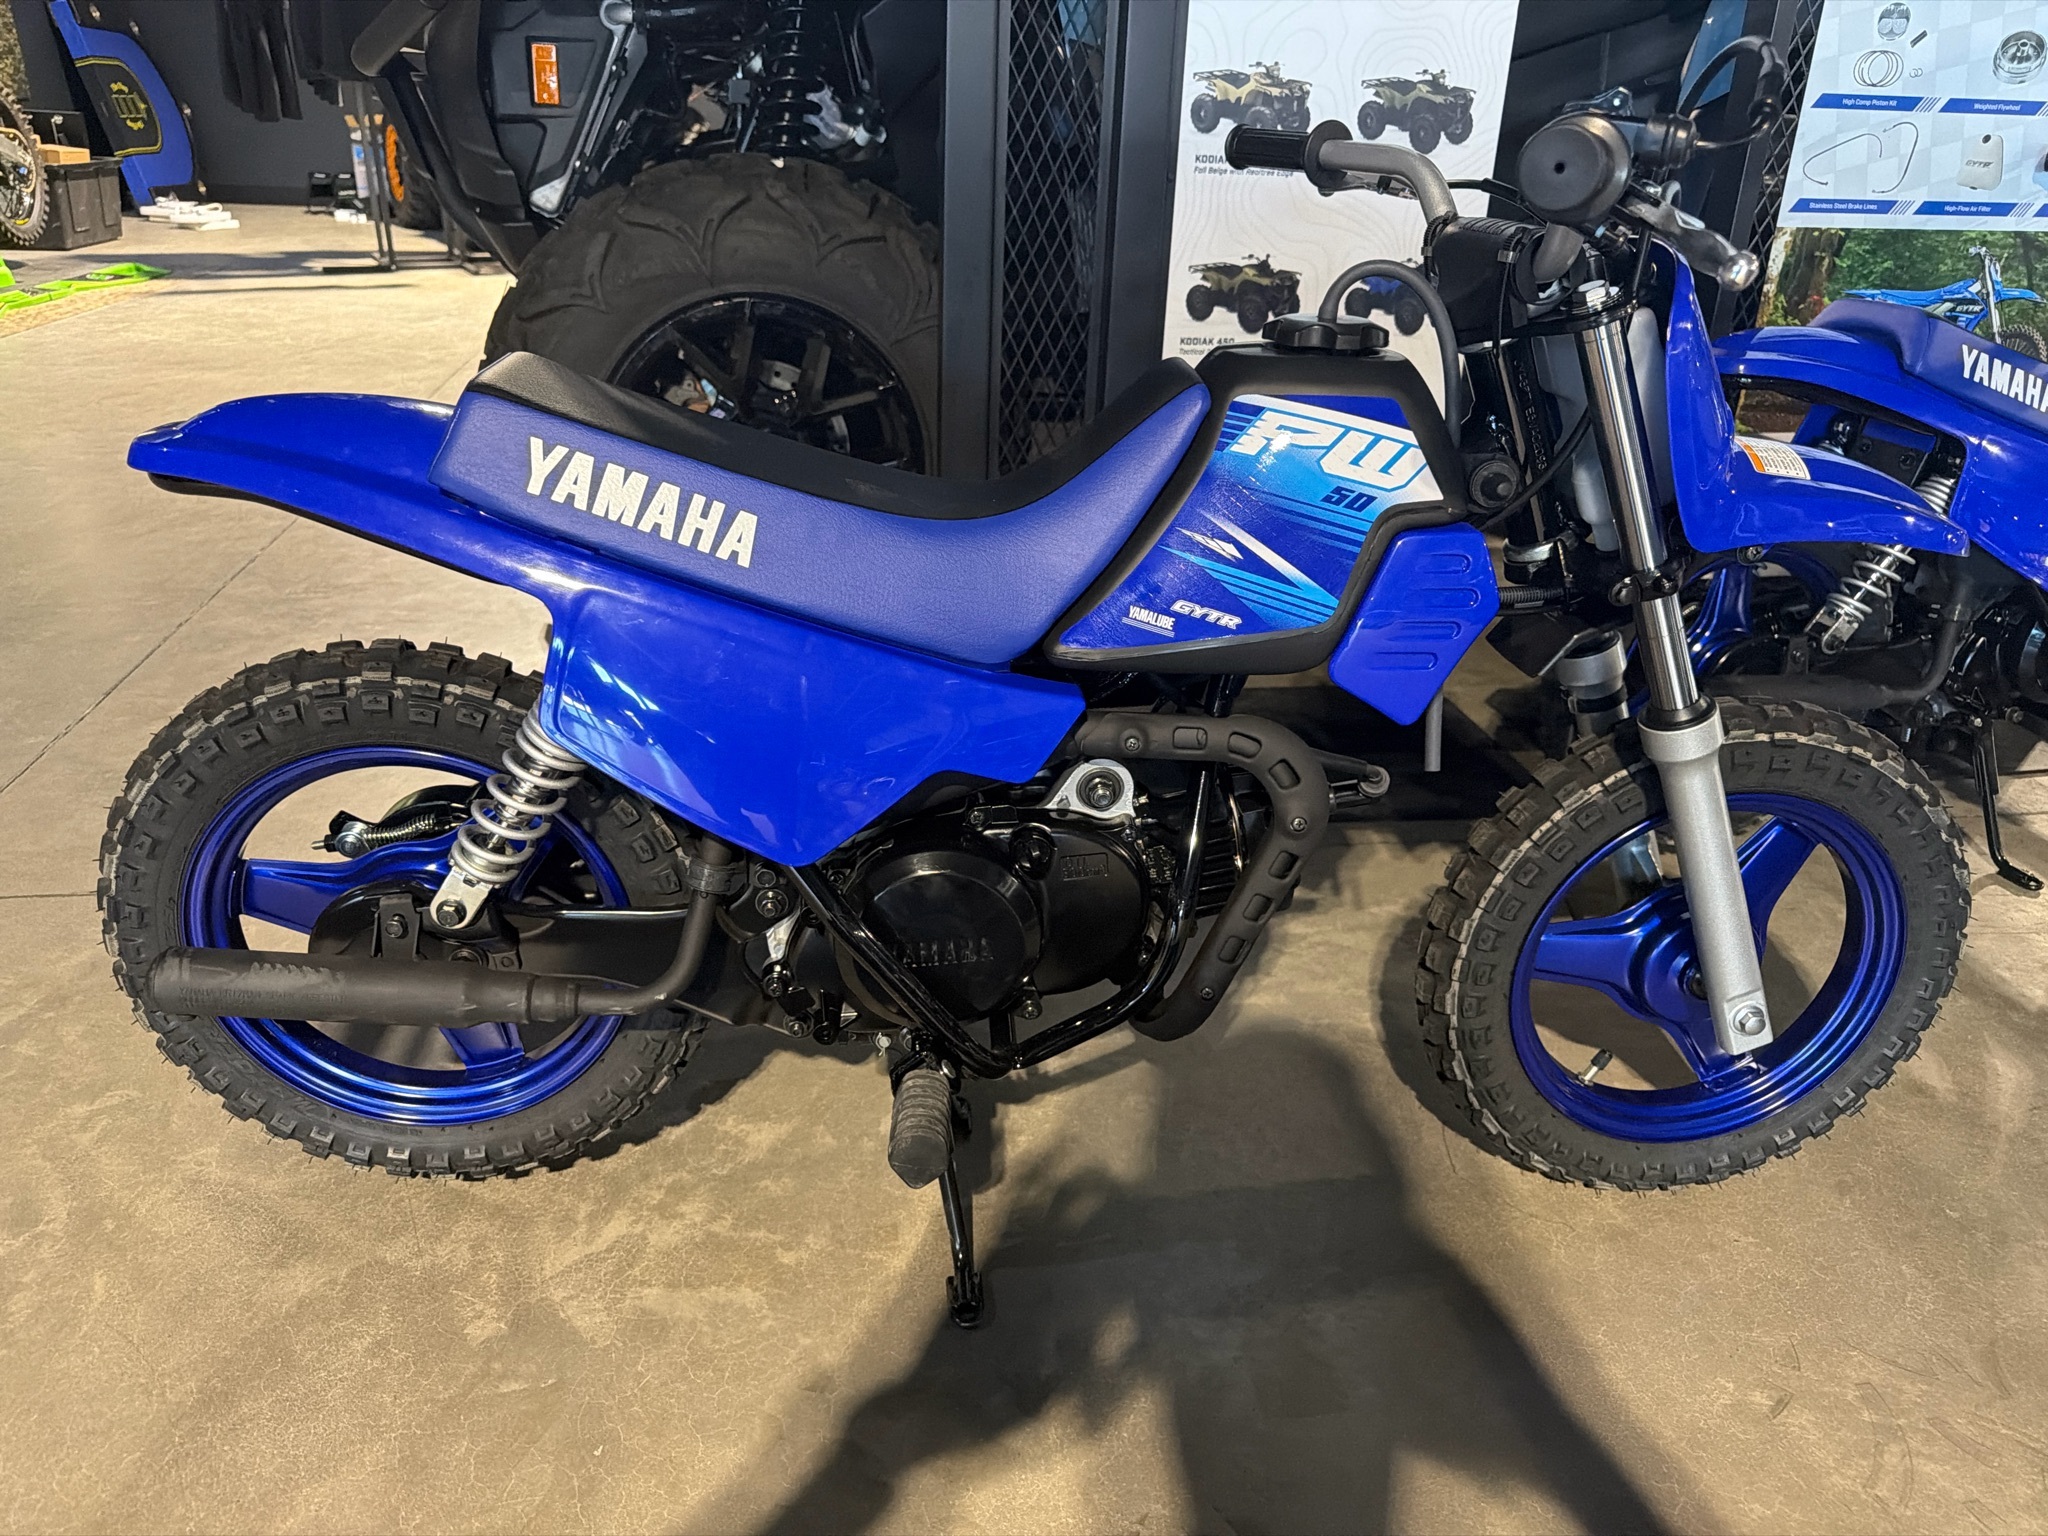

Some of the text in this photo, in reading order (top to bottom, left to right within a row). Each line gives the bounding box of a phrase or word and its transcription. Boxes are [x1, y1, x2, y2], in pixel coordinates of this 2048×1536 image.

[1842, 98, 1855, 106] High
[1889, 99, 1898, 107] Kit
[1973, 103, 2021, 111] Weighted Flywheel
[1194, 154, 1228, 164] KODIA
[1193, 166, 1207, 174] Fall
[1207, 166, 1229, 176] Beige
[1956, 305, 1984, 313] GYTR
[1179, 337, 1215, 346] KODIAK
[1228, 409, 1427, 490] PW
[526, 435, 759, 569] YAMAHA
[1320, 485, 1379, 513] 50
[1128, 605, 1176, 630] YAMALUBE
[1169, 599, 1243, 630] GYTR
